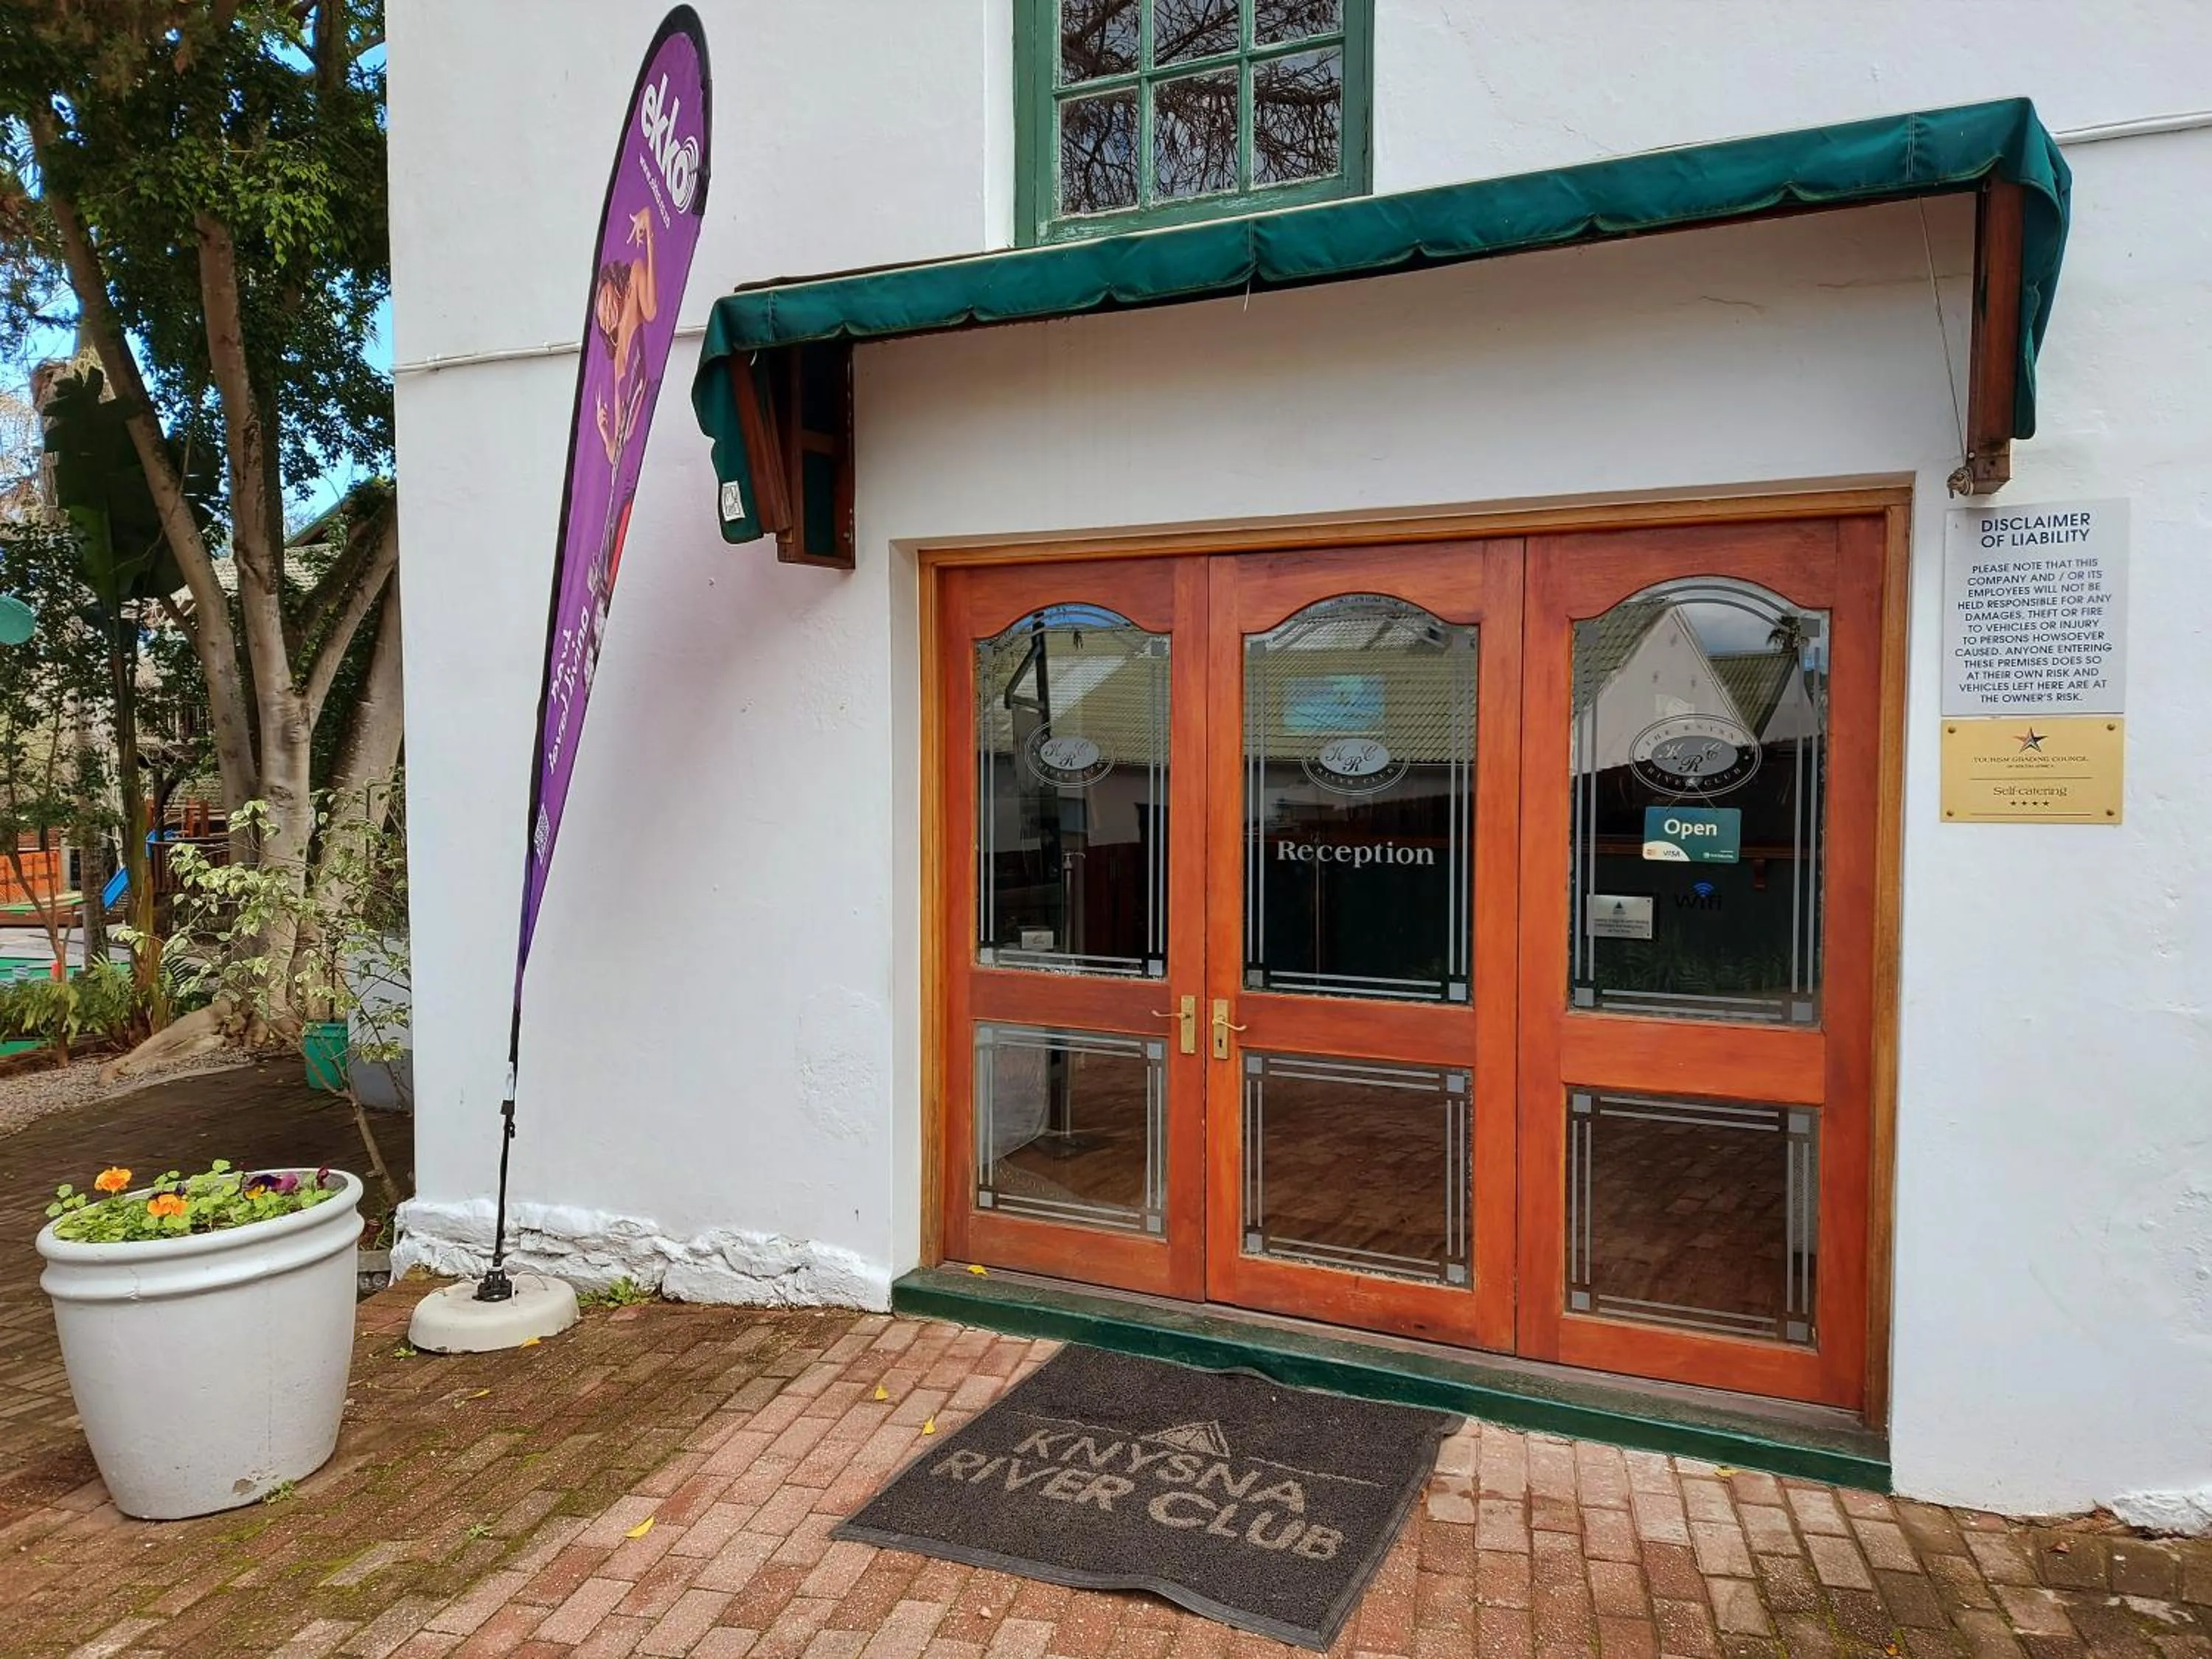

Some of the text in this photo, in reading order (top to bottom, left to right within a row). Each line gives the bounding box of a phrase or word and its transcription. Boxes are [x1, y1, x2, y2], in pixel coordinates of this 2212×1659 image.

[641, 72, 698, 214] ekko
[1982, 513, 2090, 532] DISCLAIMER
[1982, 529, 2090, 547] OF LIABILITY
[1973, 559, 2098, 574] PLEASE NOTE THAT THIS
[1967, 575, 2026, 585] COMPANY
[2031, 574, 2055, 582] AND
[2067, 571, 2085, 580] OR
[2087, 571, 2102, 579] ITS
[1968, 582, 2101, 597] EMPLOYEES WILL NOT BE
[1958, 594, 2112, 610] HELD RESPONSIBLE FOR ANY
[2028, 609, 2057, 618] THEFT
[2062, 608, 2077, 616] OR
[2081, 607, 2102, 616] FIRE
[1969, 619, 2099, 633] TO VEHICLES OR INJURY
[1963, 631, 2104, 645] TO PERSONS HOWSOEVER
[2006, 645, 2053, 655] ANYONE
[2058, 643, 2112, 653] ENTERING
[1964, 655, 2101, 668] THESE PREMISES DOES SO
[1966, 668, 2099, 680] AT THEIR OWN RISK AND
[1959, 679, 2107, 692] VEHICLES LEFT HERE ARE AT
[1980, 692, 2082, 703] THE OWNER'S RISK.
[1664, 818, 1717, 840] Open
[1276, 841, 1435, 868] Reception
[1015, 1428, 1305, 1514] KNYSNA
[930, 1448, 1343, 1559] RIVER CLUB
